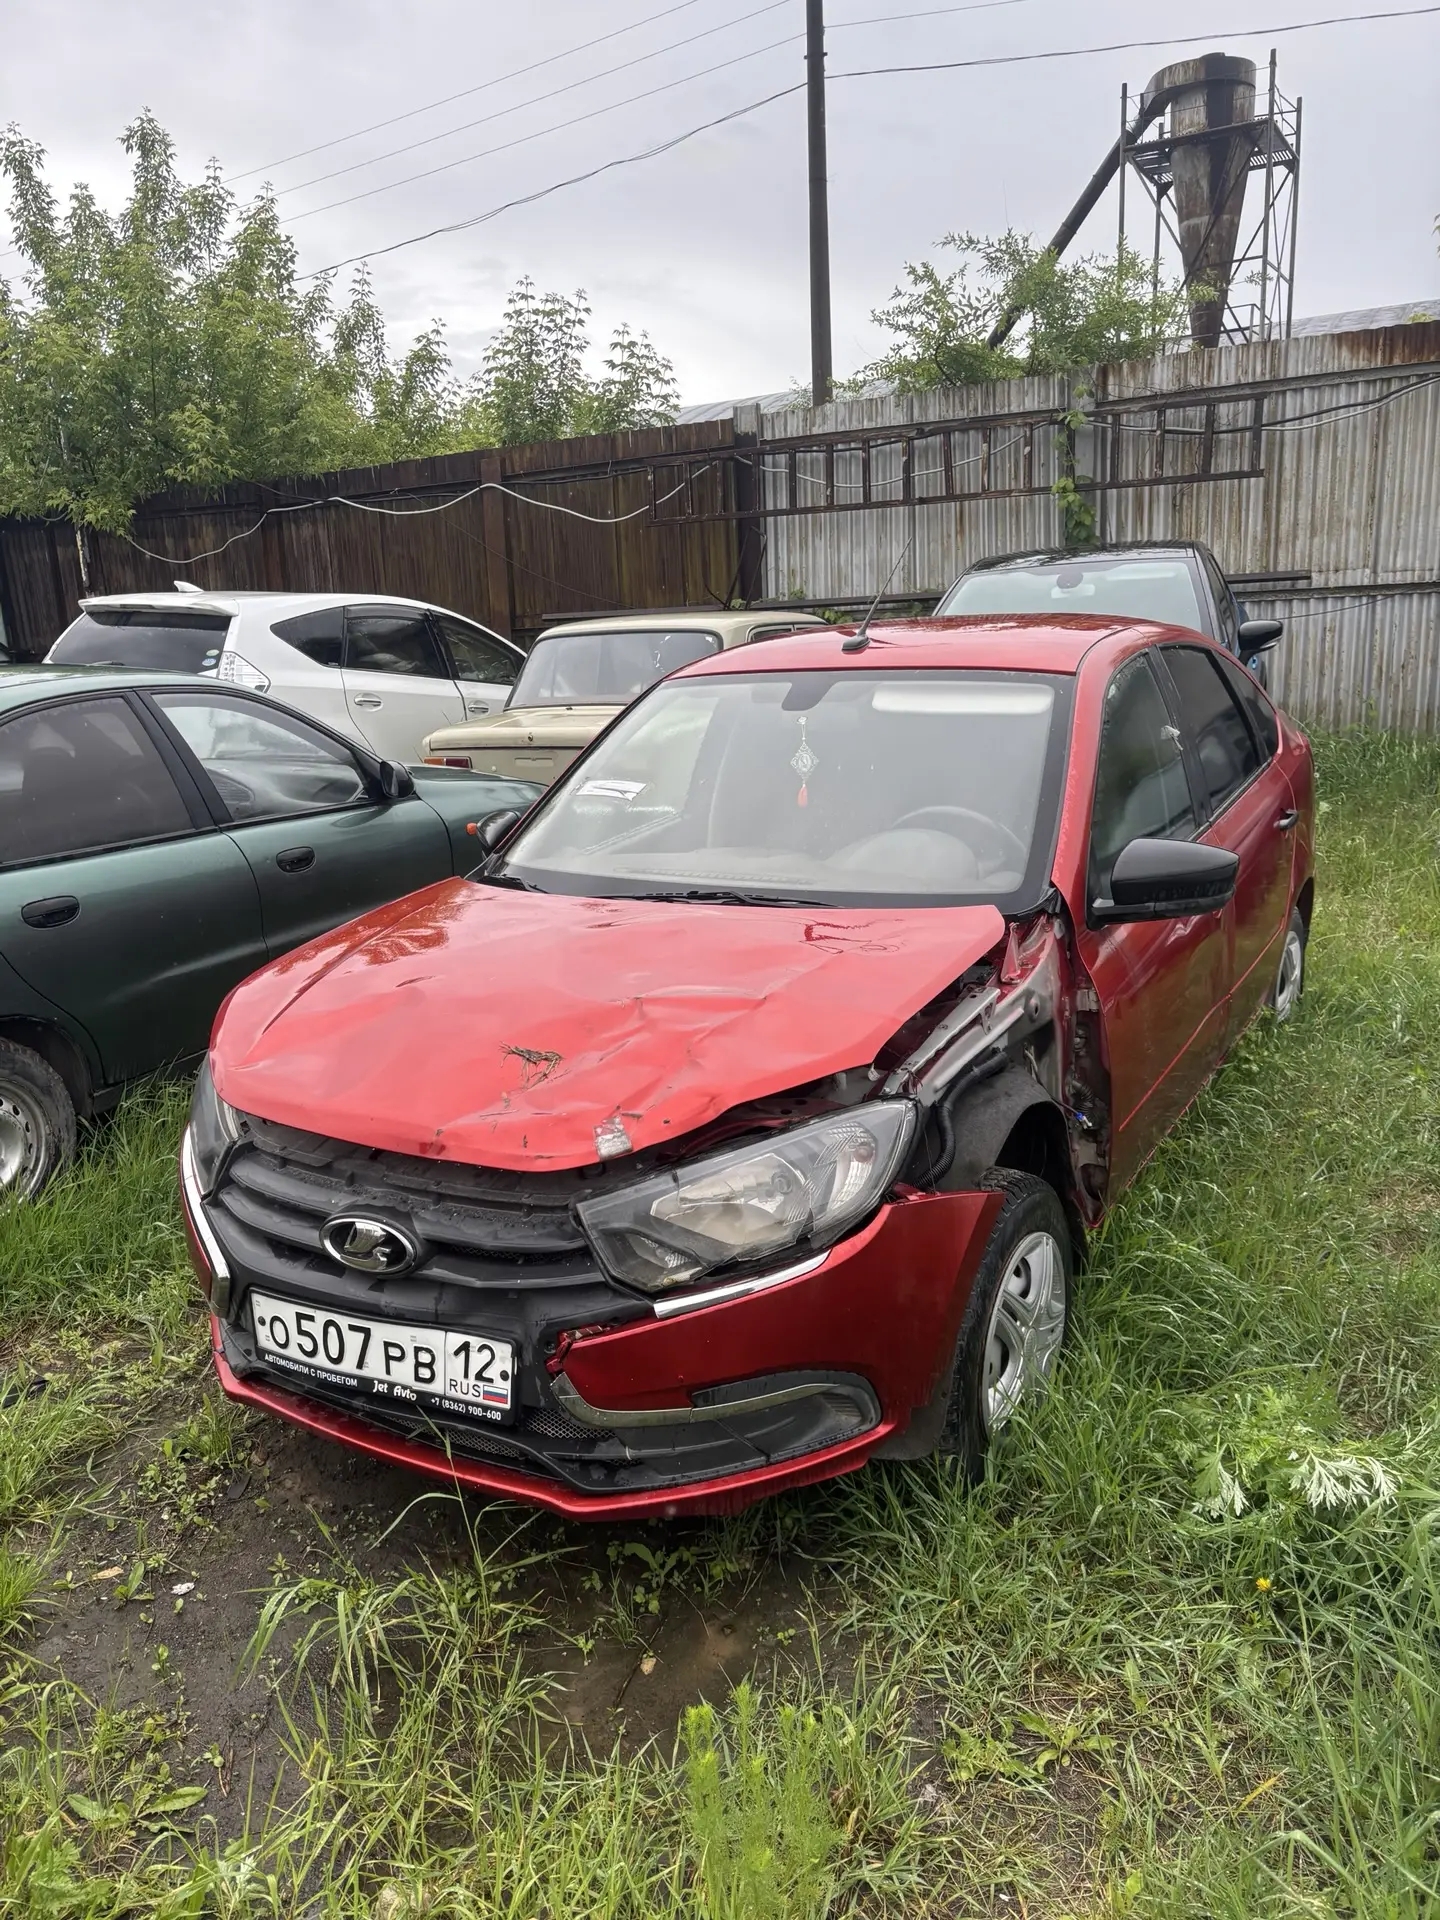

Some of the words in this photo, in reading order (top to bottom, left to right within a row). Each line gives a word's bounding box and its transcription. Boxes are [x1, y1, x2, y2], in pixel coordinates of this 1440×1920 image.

[264, 1353, 310, 1375] АВТОМОБИЛИ
[317, 1370, 358, 1387] ПРОБЕГОМ
[453, 1340, 494, 1383] 12
[372, 1380, 388, 1393] Jet
[393, 1386, 417, 1401] Avto
[449, 1379, 481, 1398] RUS
[430, 1397, 440, 1406] +7
[442, 1399, 466, 1413] (8362)
[468, 1405, 502, 1421] 900-600
